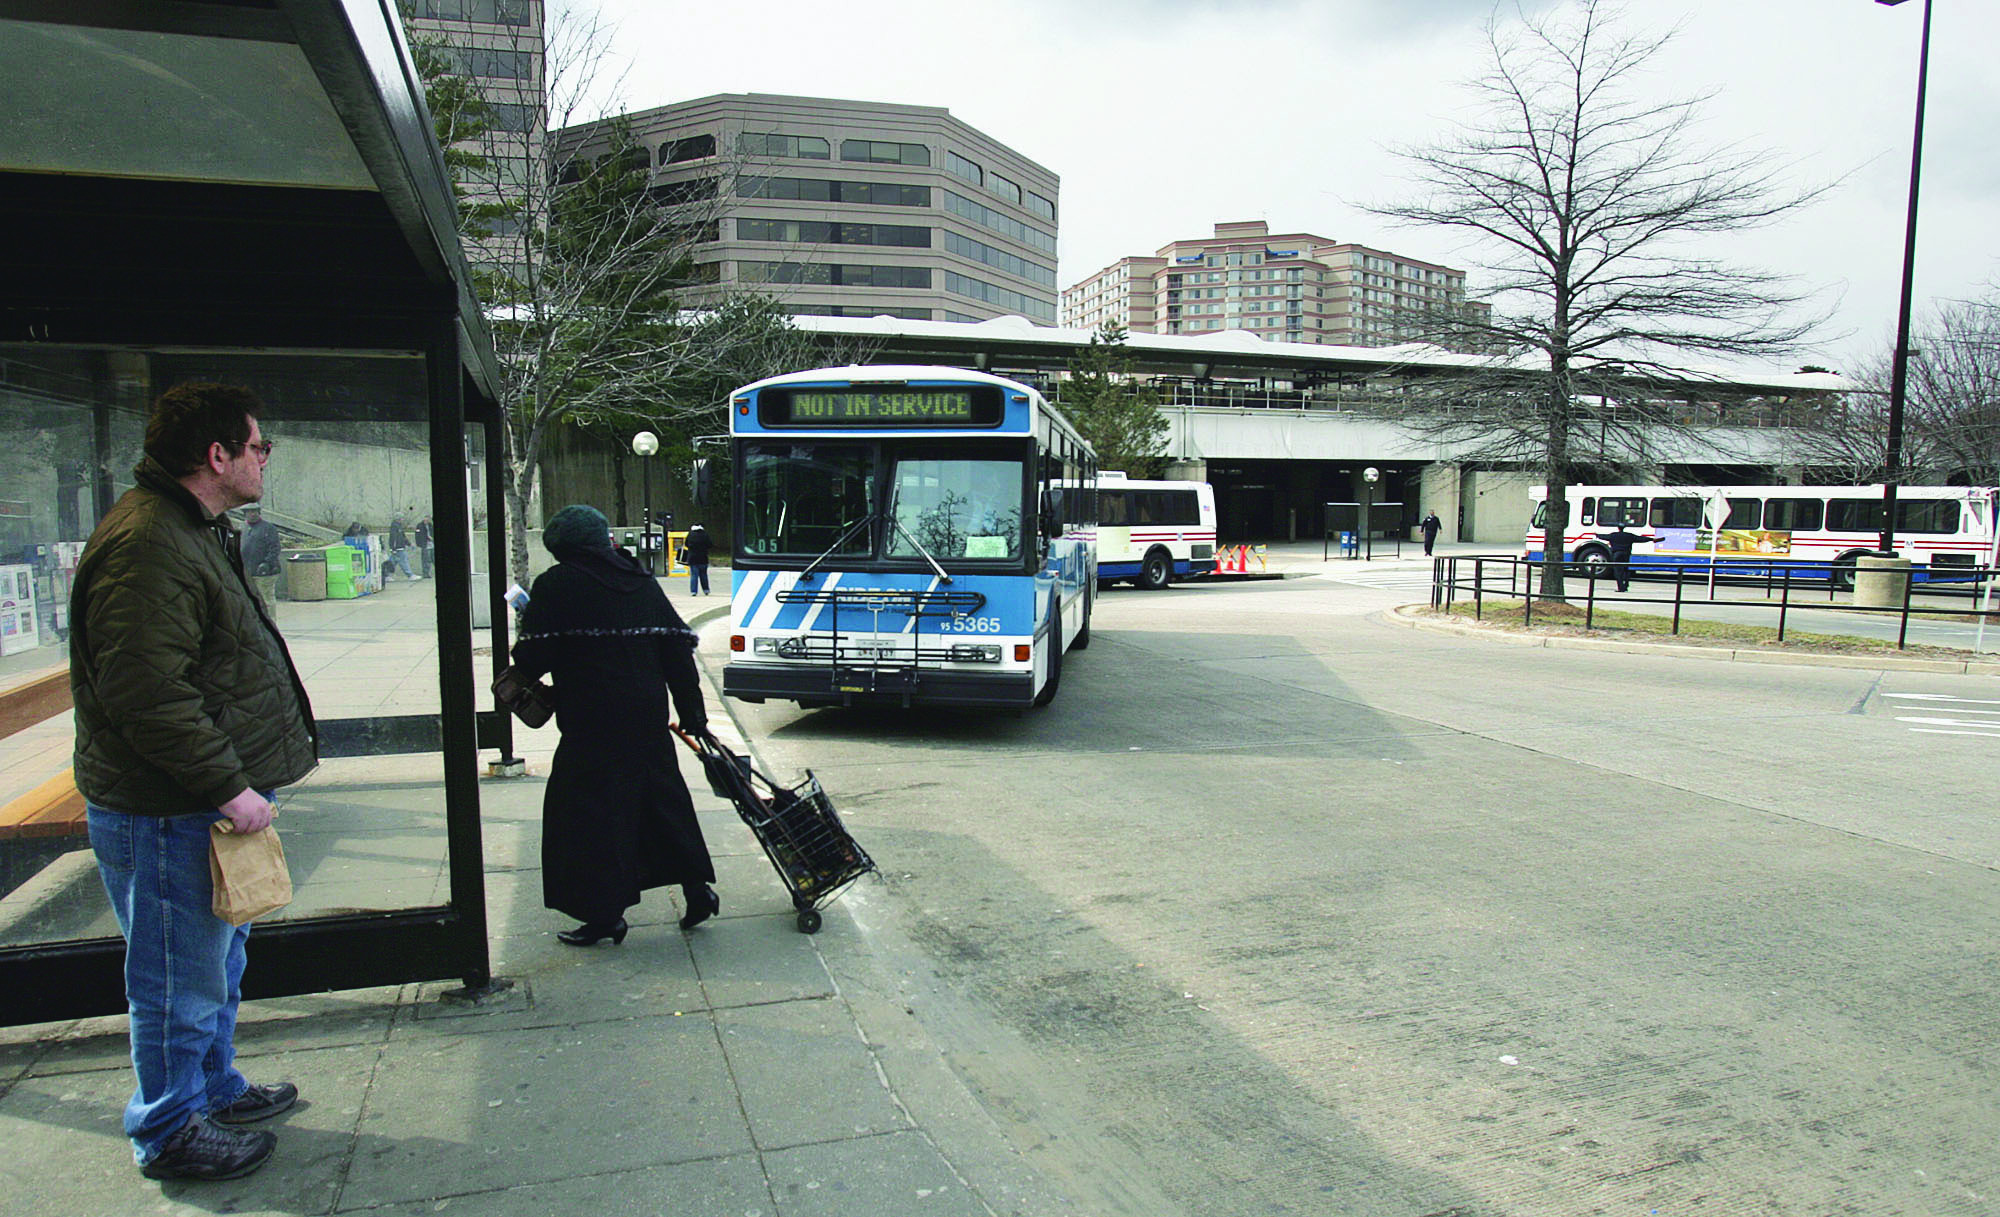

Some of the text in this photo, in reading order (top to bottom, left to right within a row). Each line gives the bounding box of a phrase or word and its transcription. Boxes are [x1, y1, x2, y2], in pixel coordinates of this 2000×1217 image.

[795, 393, 969, 416] NOT IN SERVICE
[940, 616, 1001, 633] 95 5365
